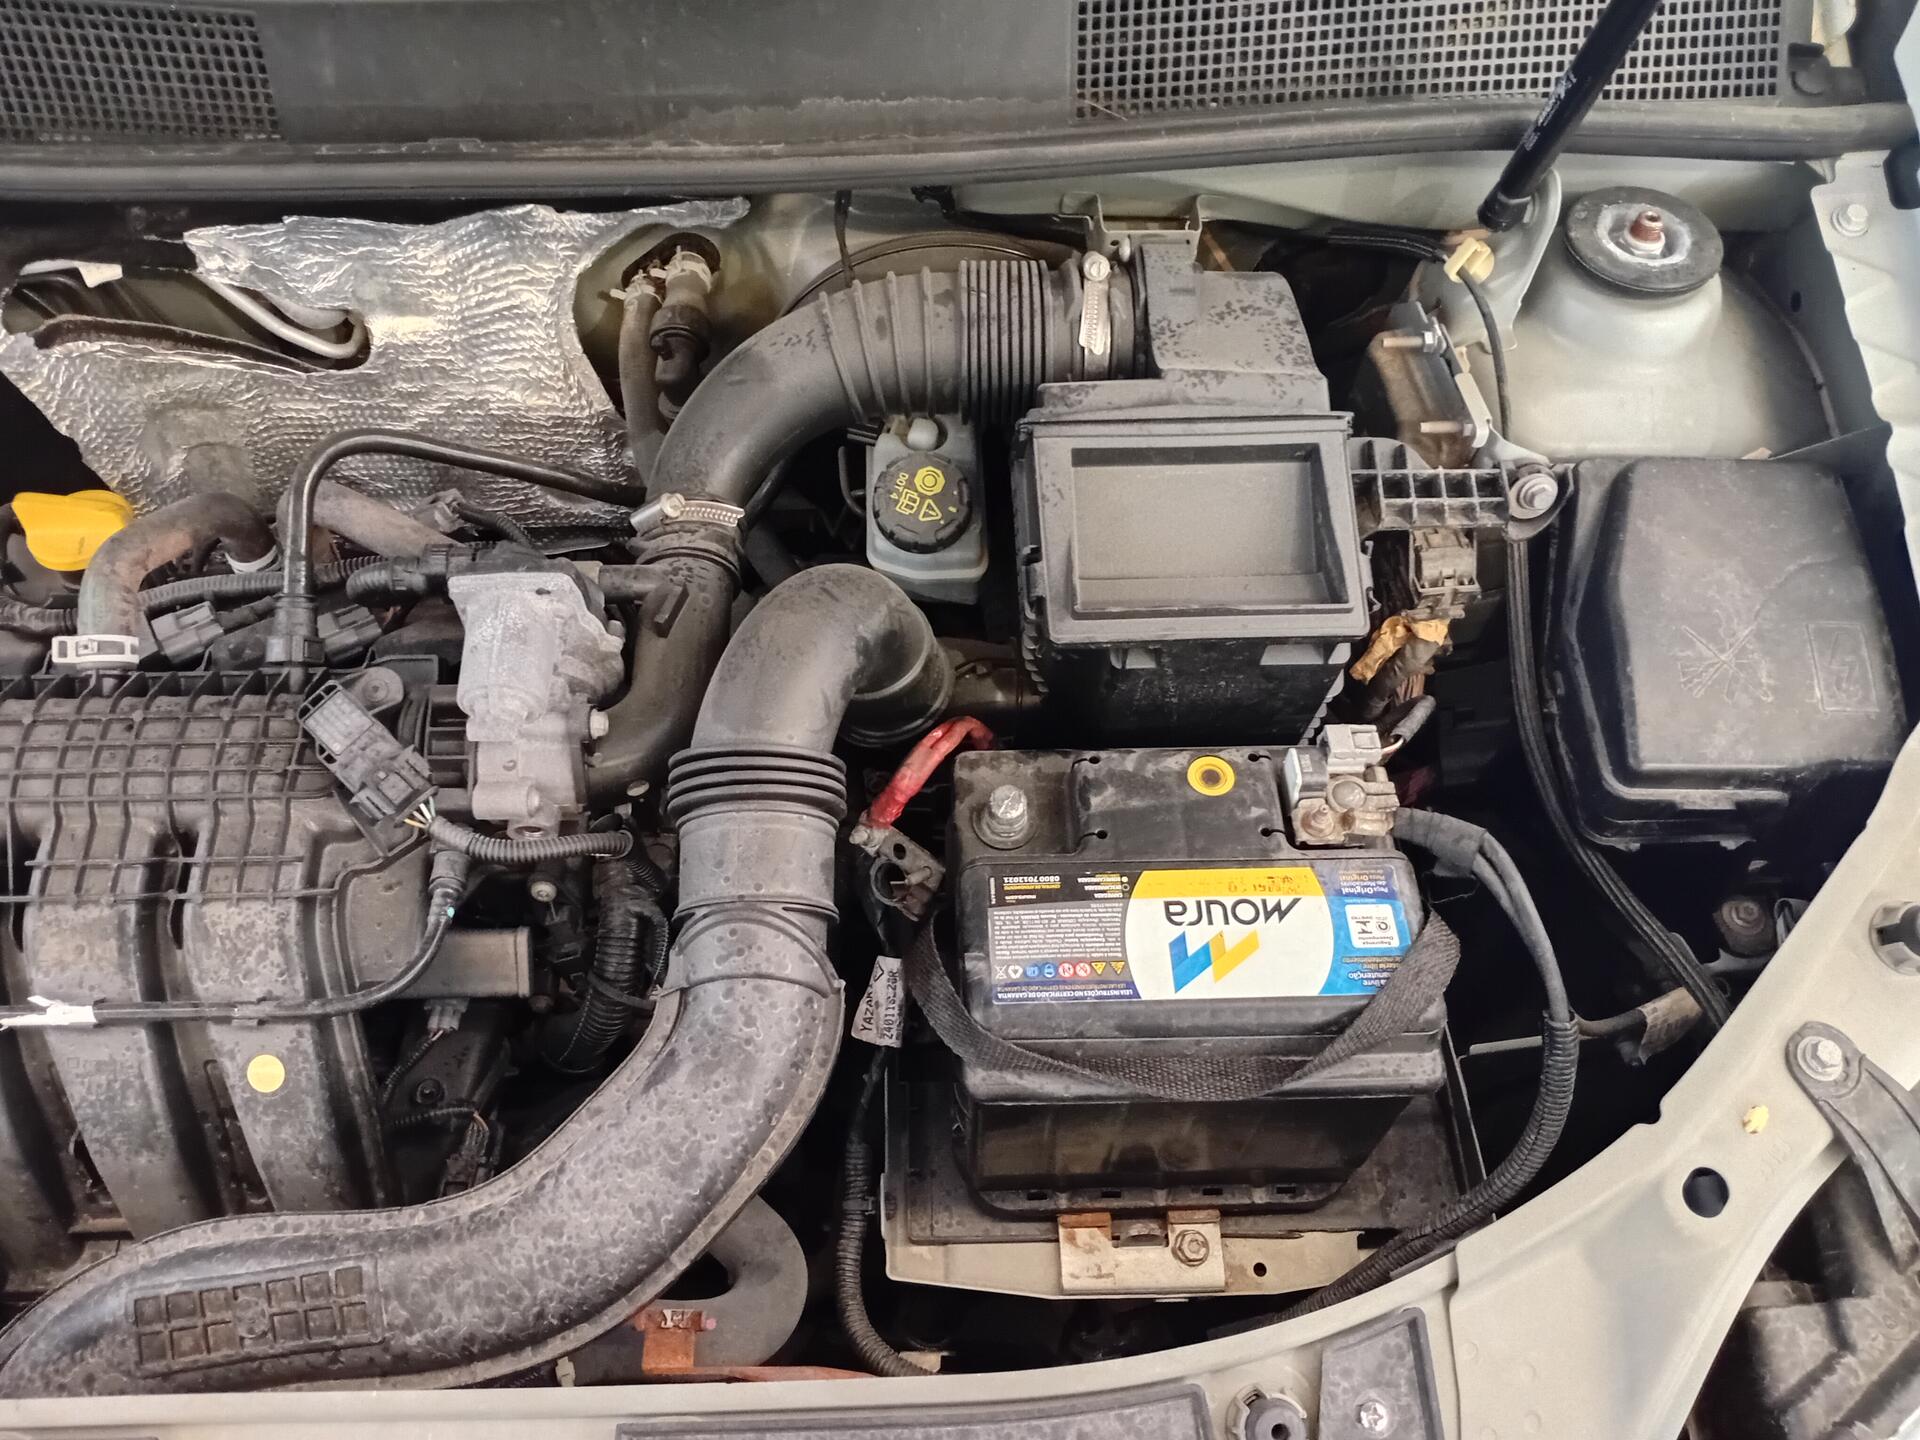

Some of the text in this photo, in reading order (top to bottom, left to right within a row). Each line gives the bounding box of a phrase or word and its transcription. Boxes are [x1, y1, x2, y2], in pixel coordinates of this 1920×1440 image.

[890, 472, 909, 500] DOT 4
[1341, 886, 1373, 894] Original
[1084, 989, 1120, 997] INSTRUÇÕES
